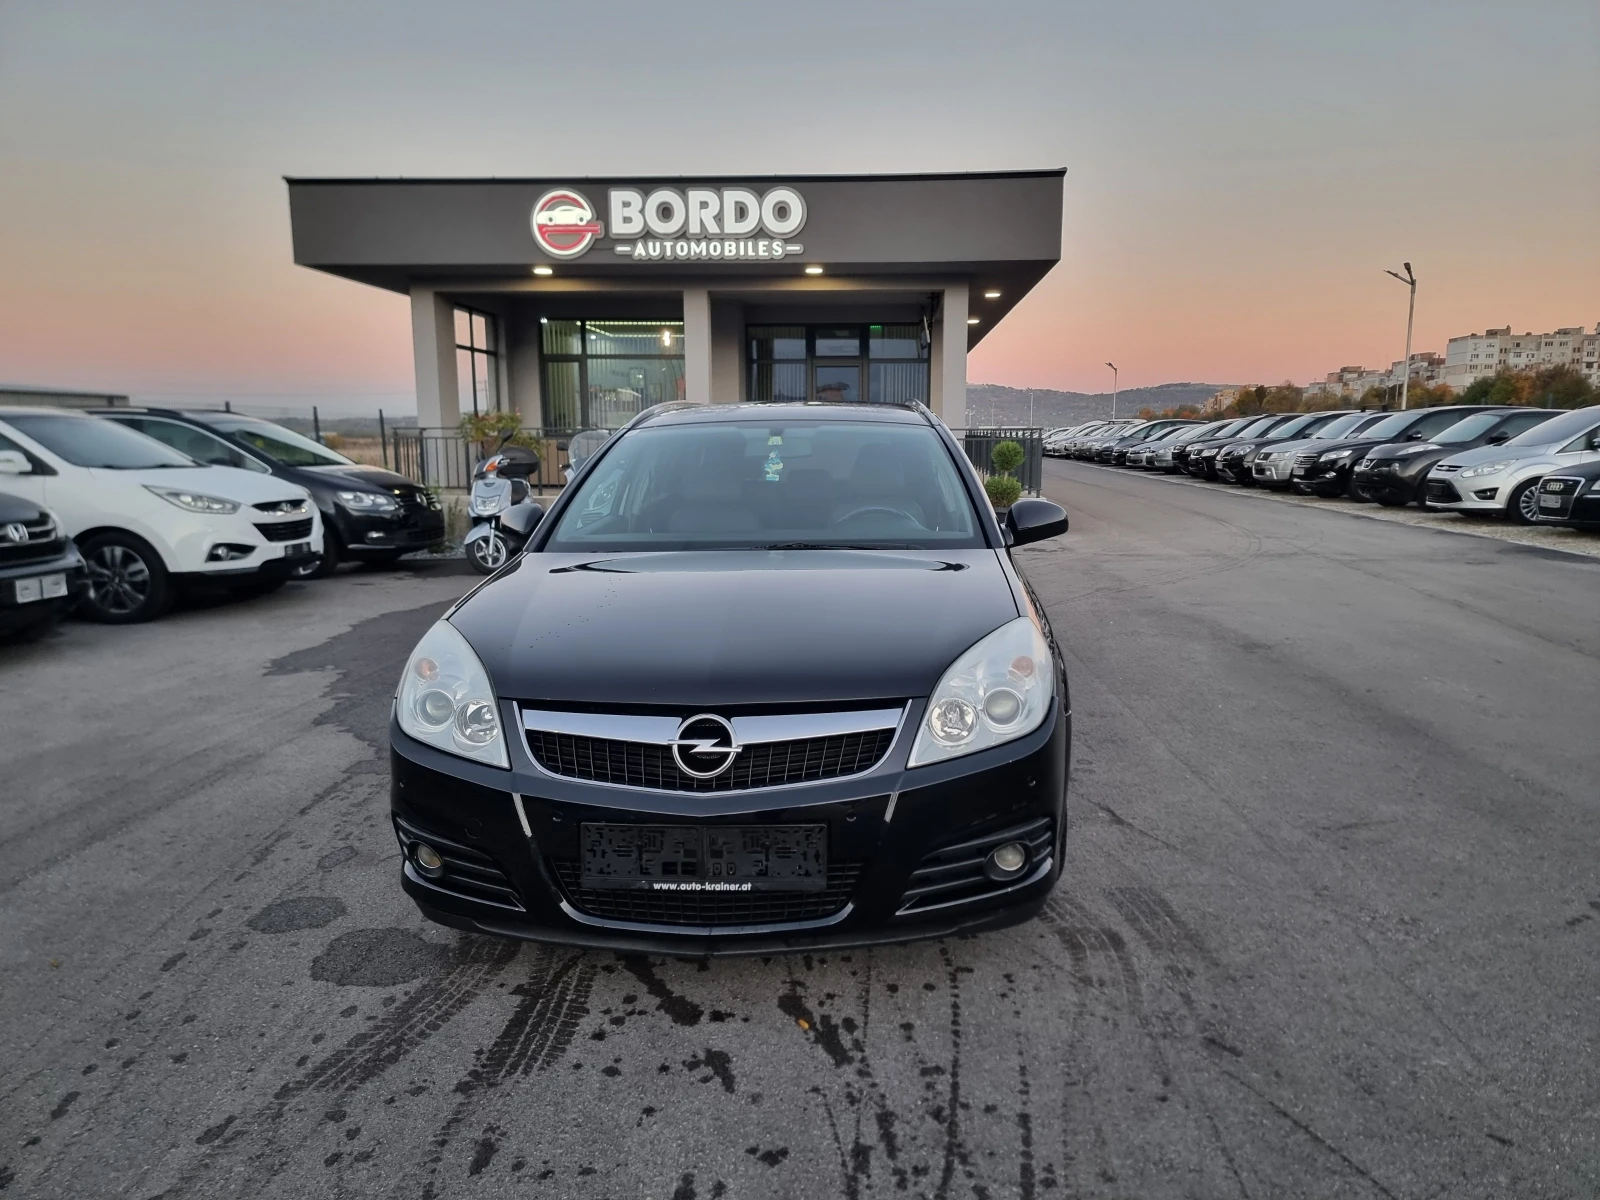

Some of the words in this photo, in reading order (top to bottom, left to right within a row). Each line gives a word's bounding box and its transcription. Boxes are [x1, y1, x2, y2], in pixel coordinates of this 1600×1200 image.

[610, 189, 803, 235] BORDO
[634, 241, 783, 257] AUTOMOBILES
[653, 881, 752, 891] www.auto-krainer.at
